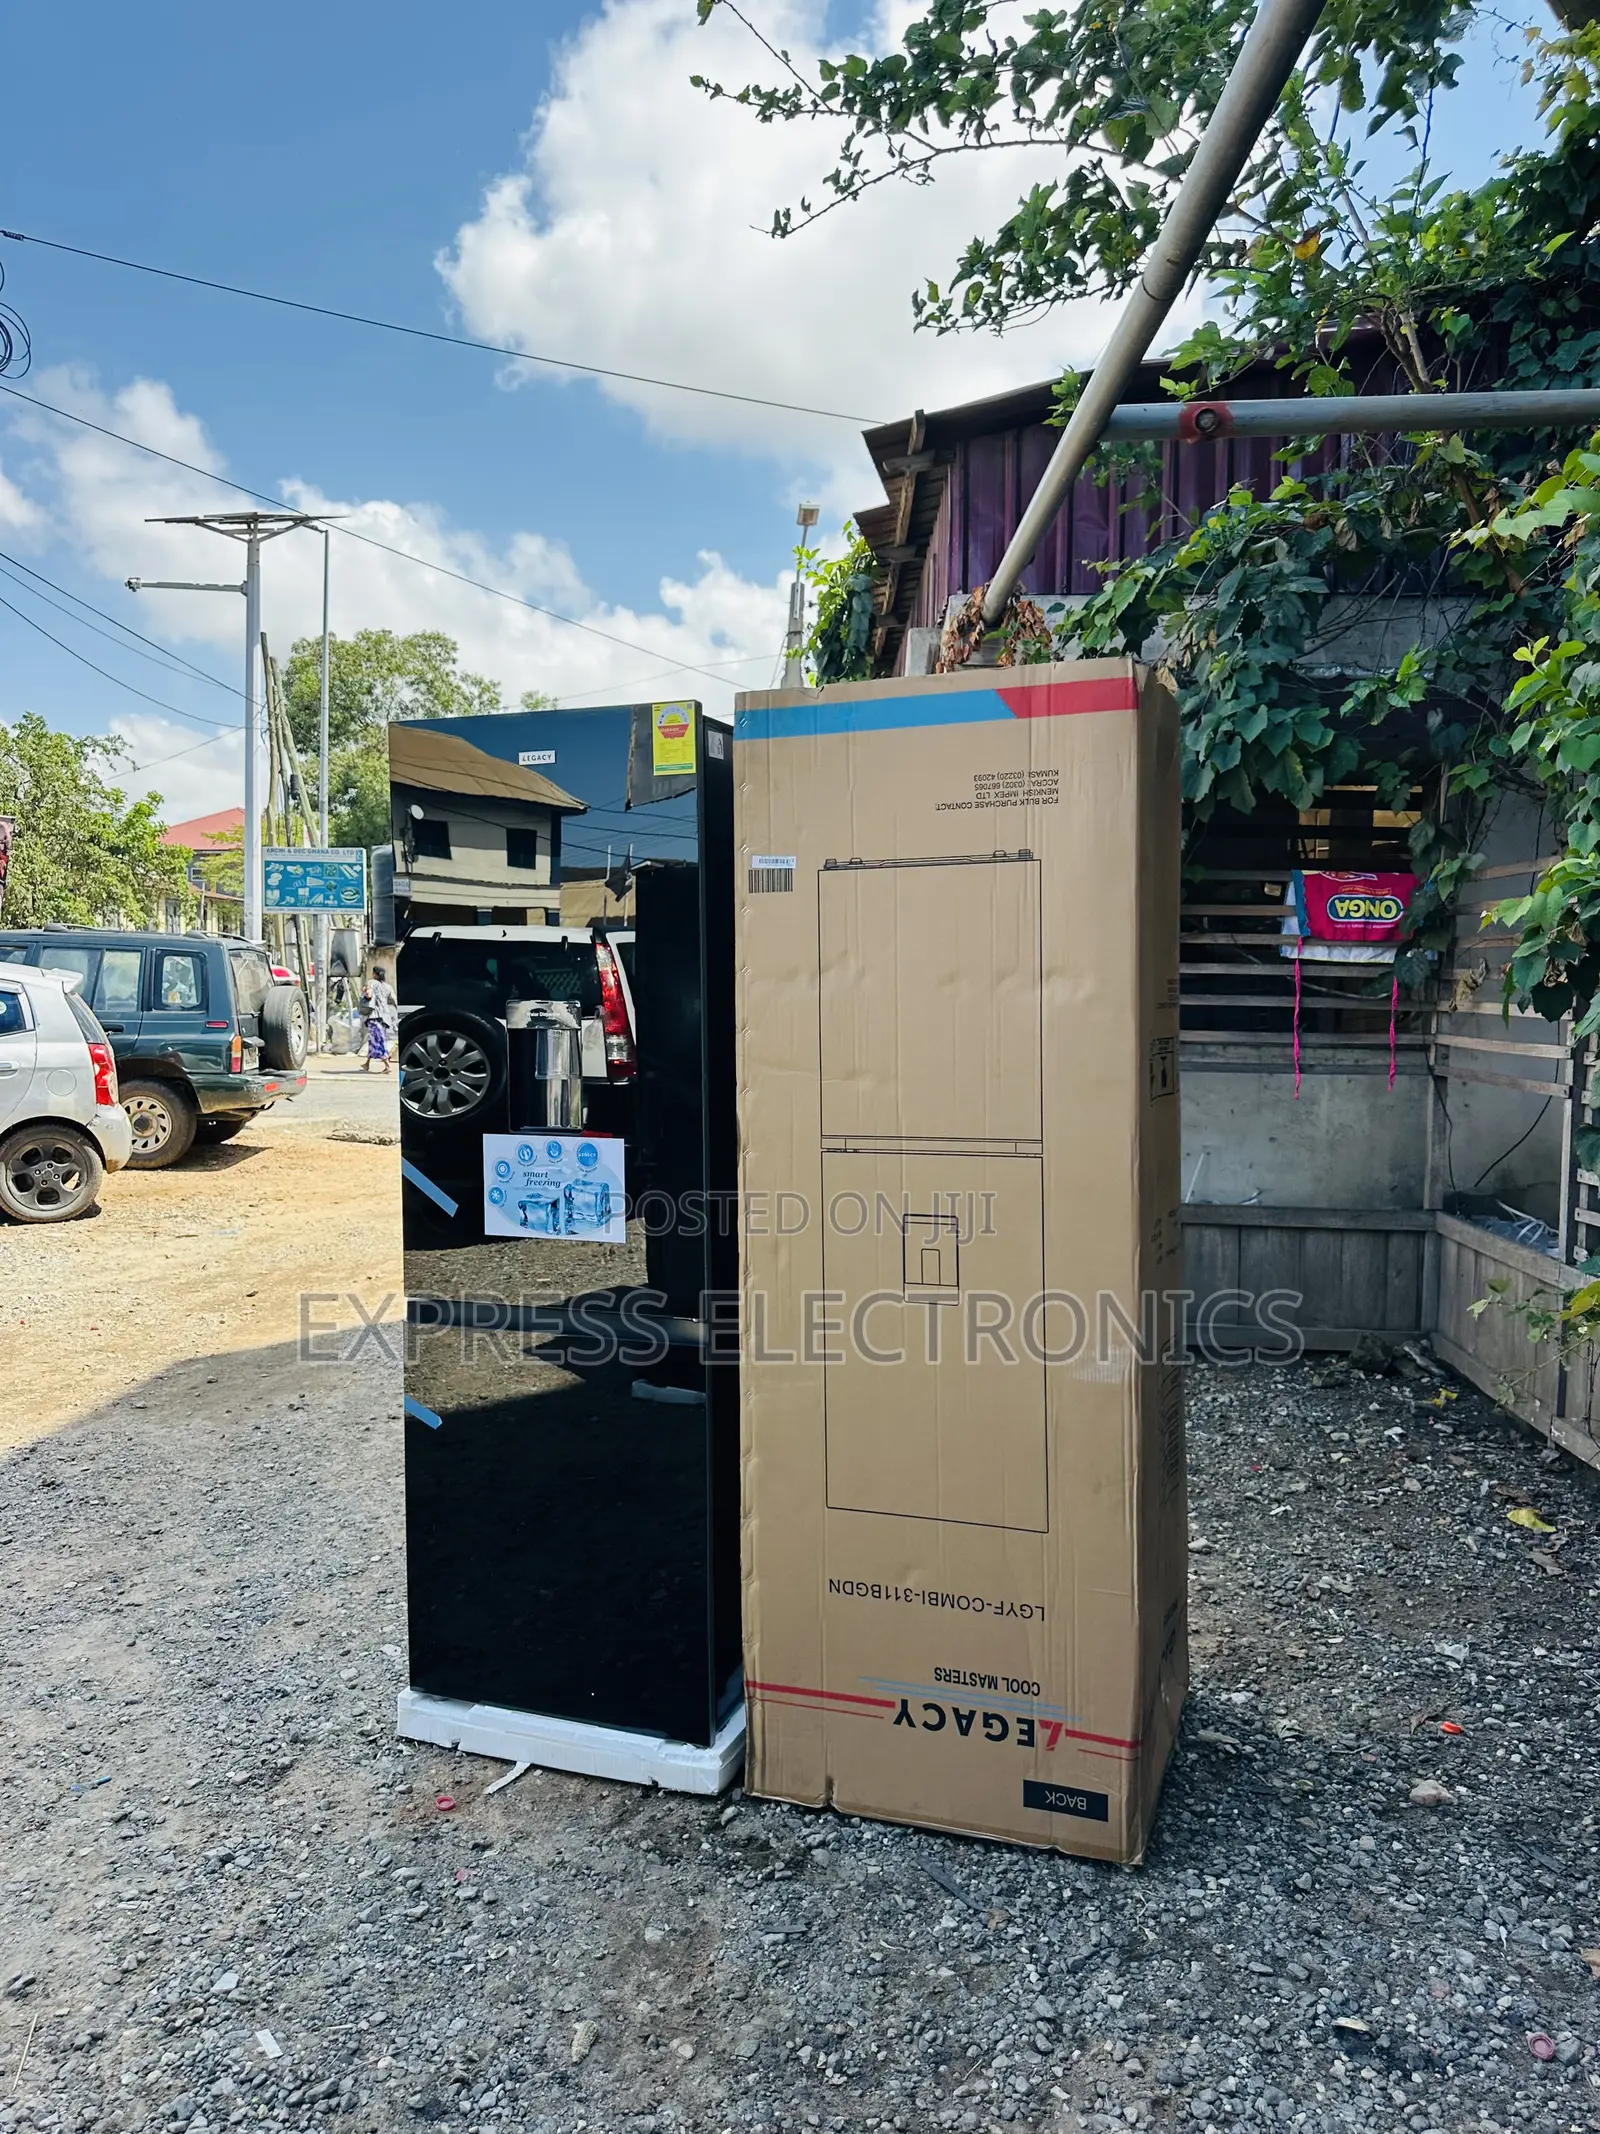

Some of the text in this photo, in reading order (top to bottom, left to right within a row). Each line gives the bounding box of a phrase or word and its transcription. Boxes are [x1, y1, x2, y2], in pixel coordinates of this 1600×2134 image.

[522, 753, 552, 762] LEGACY
[973, 773, 996, 782] 42093
[997, 771, 1025, 781] (03220)
[974, 782, 1001, 791] 667065
[1002, 780, 1025, 789] (0302)
[975, 787, 1059, 800] MENKISH IMPEX LTD
[974, 799, 1018, 809] PURCHASE
[1019, 797, 1040, 807] BULK
[1042, 796, 1059, 805] FOR
[1334, 899, 1397, 918] ONGA
[522, 1171, 549, 1179] smart
[524, 1178, 562, 1188] freezing
[828, 1578, 1045, 1622] LGYF-COMBI-311BGDN
[933, 1666, 1041, 1697] COOL MASTERS
[892, 1698, 1064, 1752] LEGACY
[1045, 1790, 1087, 1811] BACK
